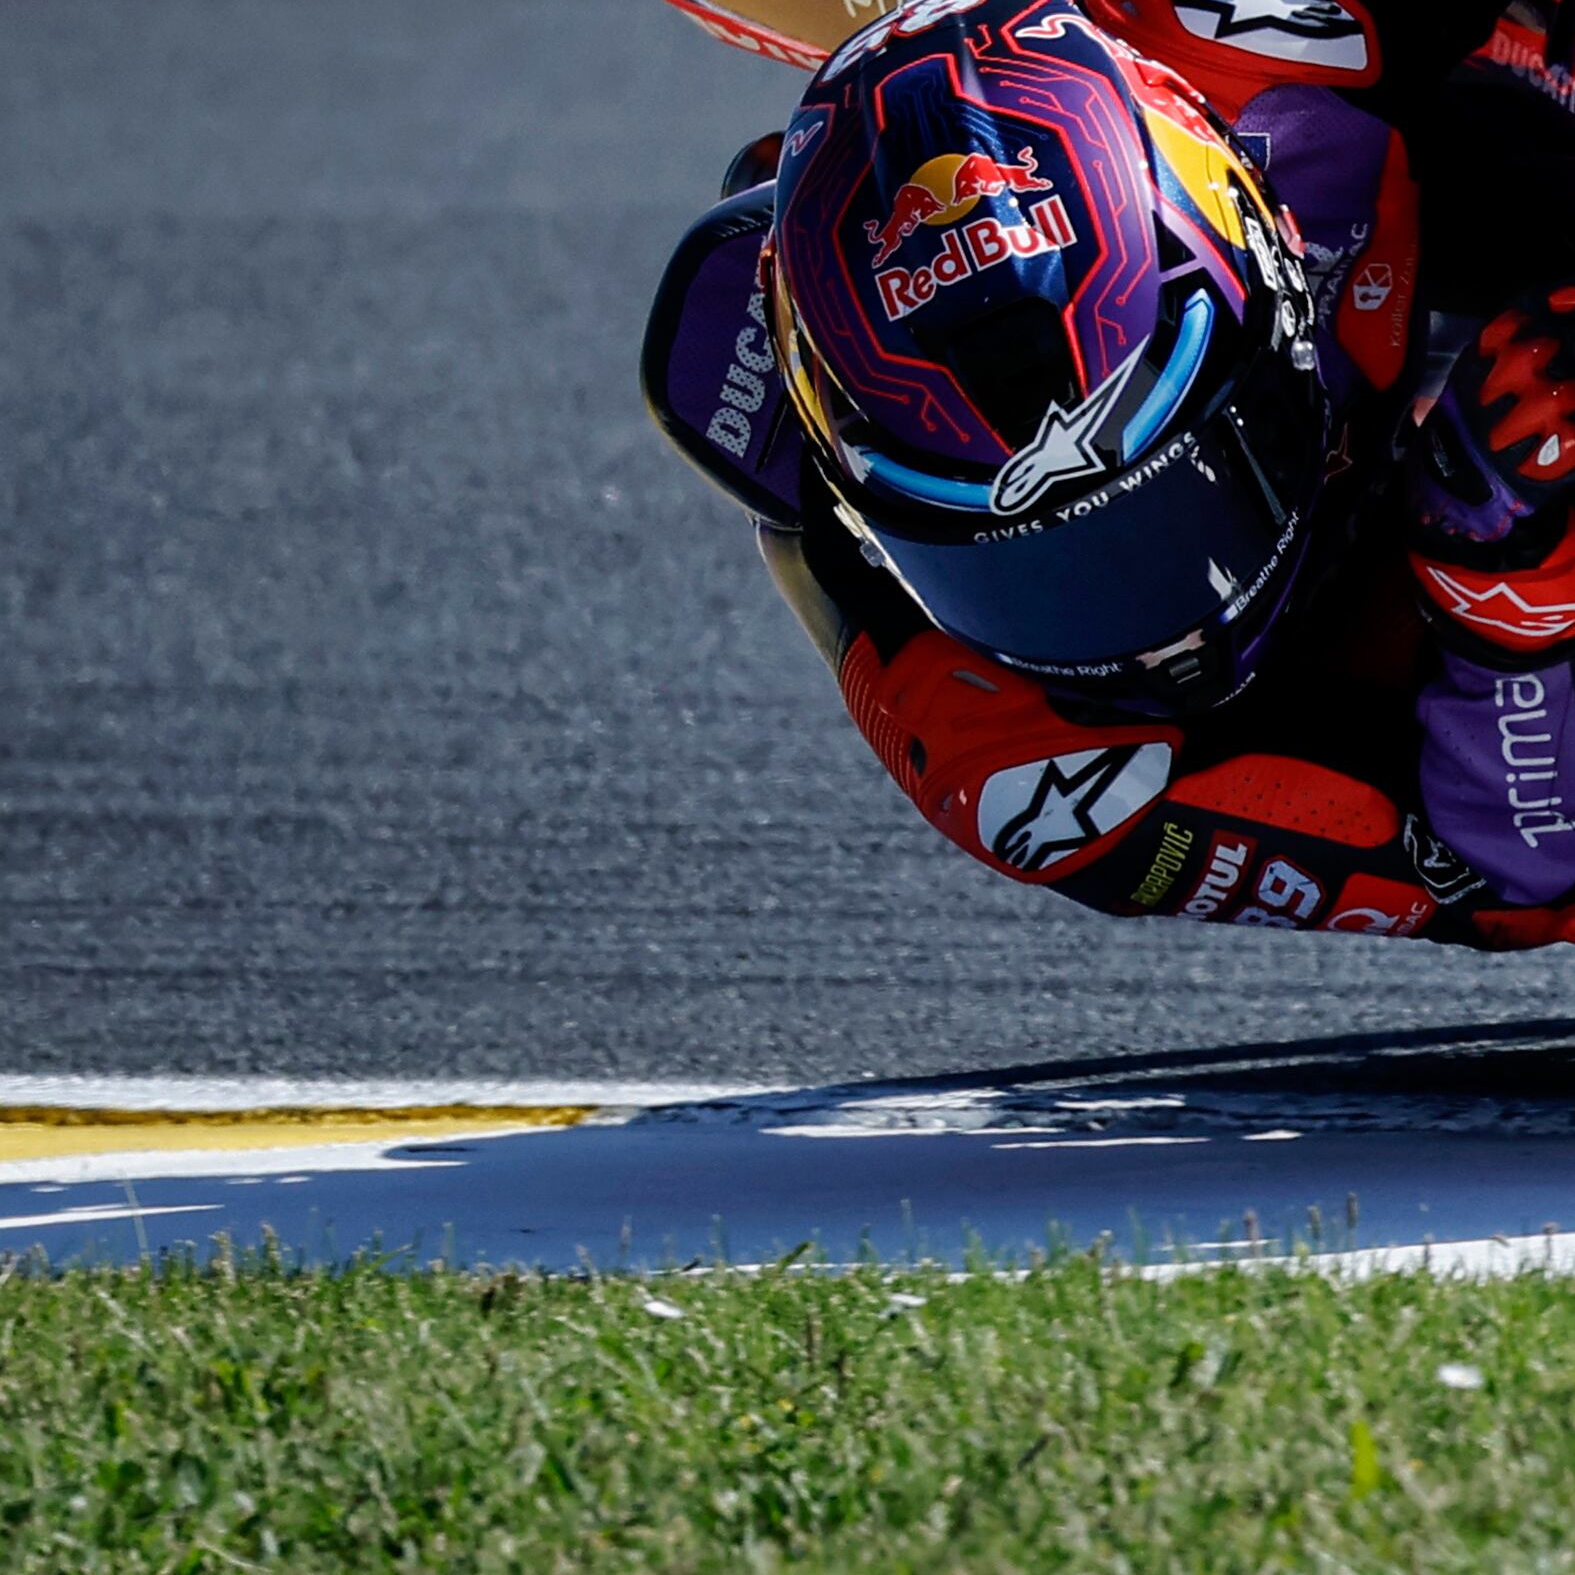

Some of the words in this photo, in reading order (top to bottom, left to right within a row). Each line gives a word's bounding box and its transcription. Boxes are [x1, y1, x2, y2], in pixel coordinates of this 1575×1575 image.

[875, 228, 973, 323] Red
[961, 193, 1078, 272] Bull
[973, 519, 1045, 545] GIVES
[1056, 491, 1111, 523] YOU
[1119, 431, 1197, 491] WINGS
[1232, 555, 1280, 612] Breathe
[1275, 508, 1299, 556] Right
[1011, 658, 1076, 677] Breathe
[1076, 661, 1124, 678] Right
